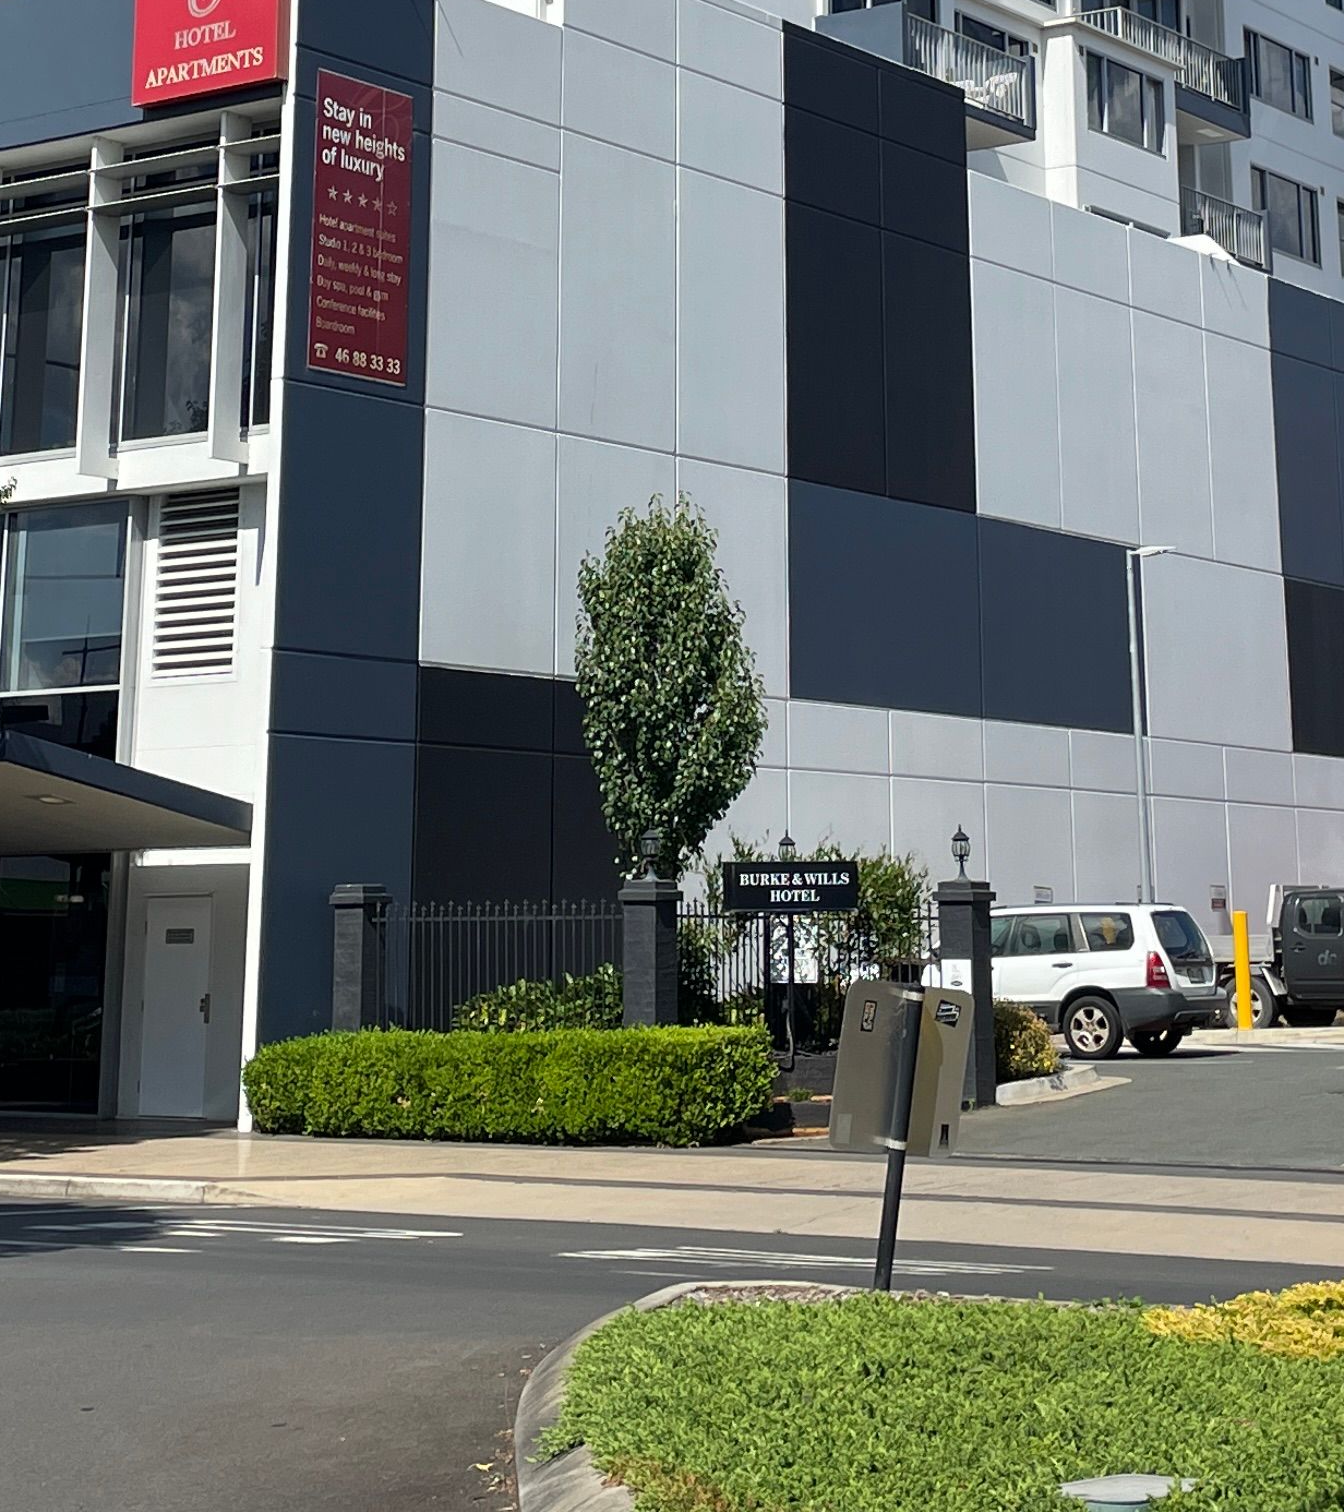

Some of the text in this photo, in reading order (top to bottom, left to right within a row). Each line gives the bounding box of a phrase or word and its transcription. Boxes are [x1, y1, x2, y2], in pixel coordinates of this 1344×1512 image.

[174, 20, 236, 50] HOTEL
[144, 46, 264, 88] APARTMENTS
[323, 97, 372, 129] Stay in
[323, 124, 406, 162] new heights
[322, 146, 385, 182] of luxury
[319, 213, 339, 228] Hotel
[318, 233, 342, 250] Studio
[351, 242, 358, 254] 2
[316, 295, 357, 316] Conference
[335, 347, 401, 375] 46 88 33 33
[739, 872, 850, 886] BURKE & WILLS
[770, 889, 820, 902] HOTEL
